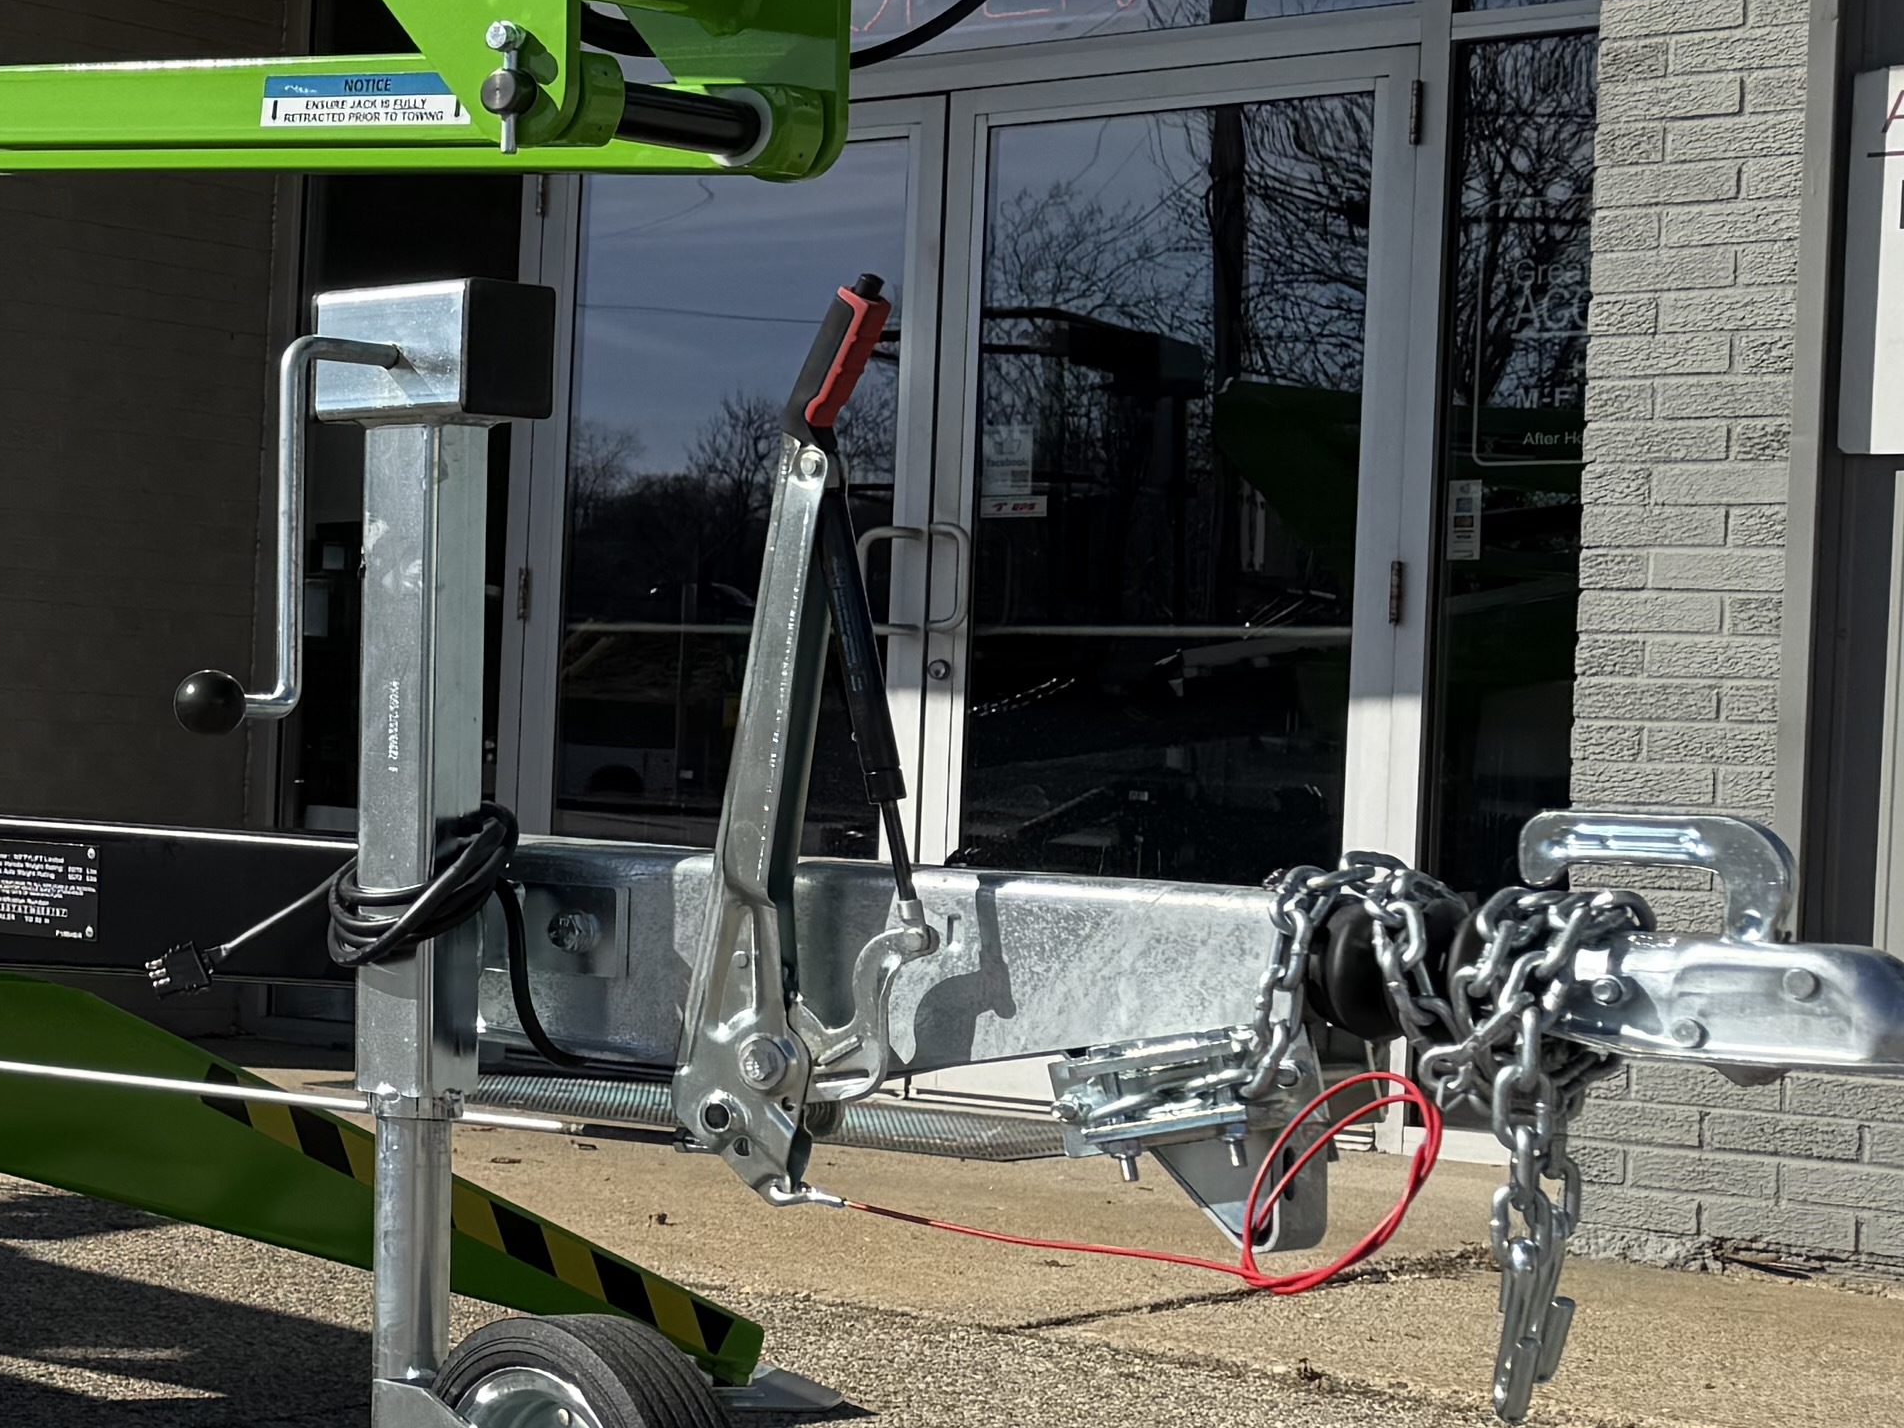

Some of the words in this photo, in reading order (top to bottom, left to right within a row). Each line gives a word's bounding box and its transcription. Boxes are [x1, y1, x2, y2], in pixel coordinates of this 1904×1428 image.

[344, 78, 392, 92] NOTICE
[305, 99, 347, 110] ENSURE
[349, 99, 377, 109] JACK
[380, 99, 390, 109] IS
[393, 98, 427, 110] FULLY
[284, 112, 345, 122] RETRACTED
[348, 112, 380, 122] PRIOR
[383, 111, 398, 121] TO
[402, 111, 444, 121] TOWING
[1522, 431, 1561, 445] After
